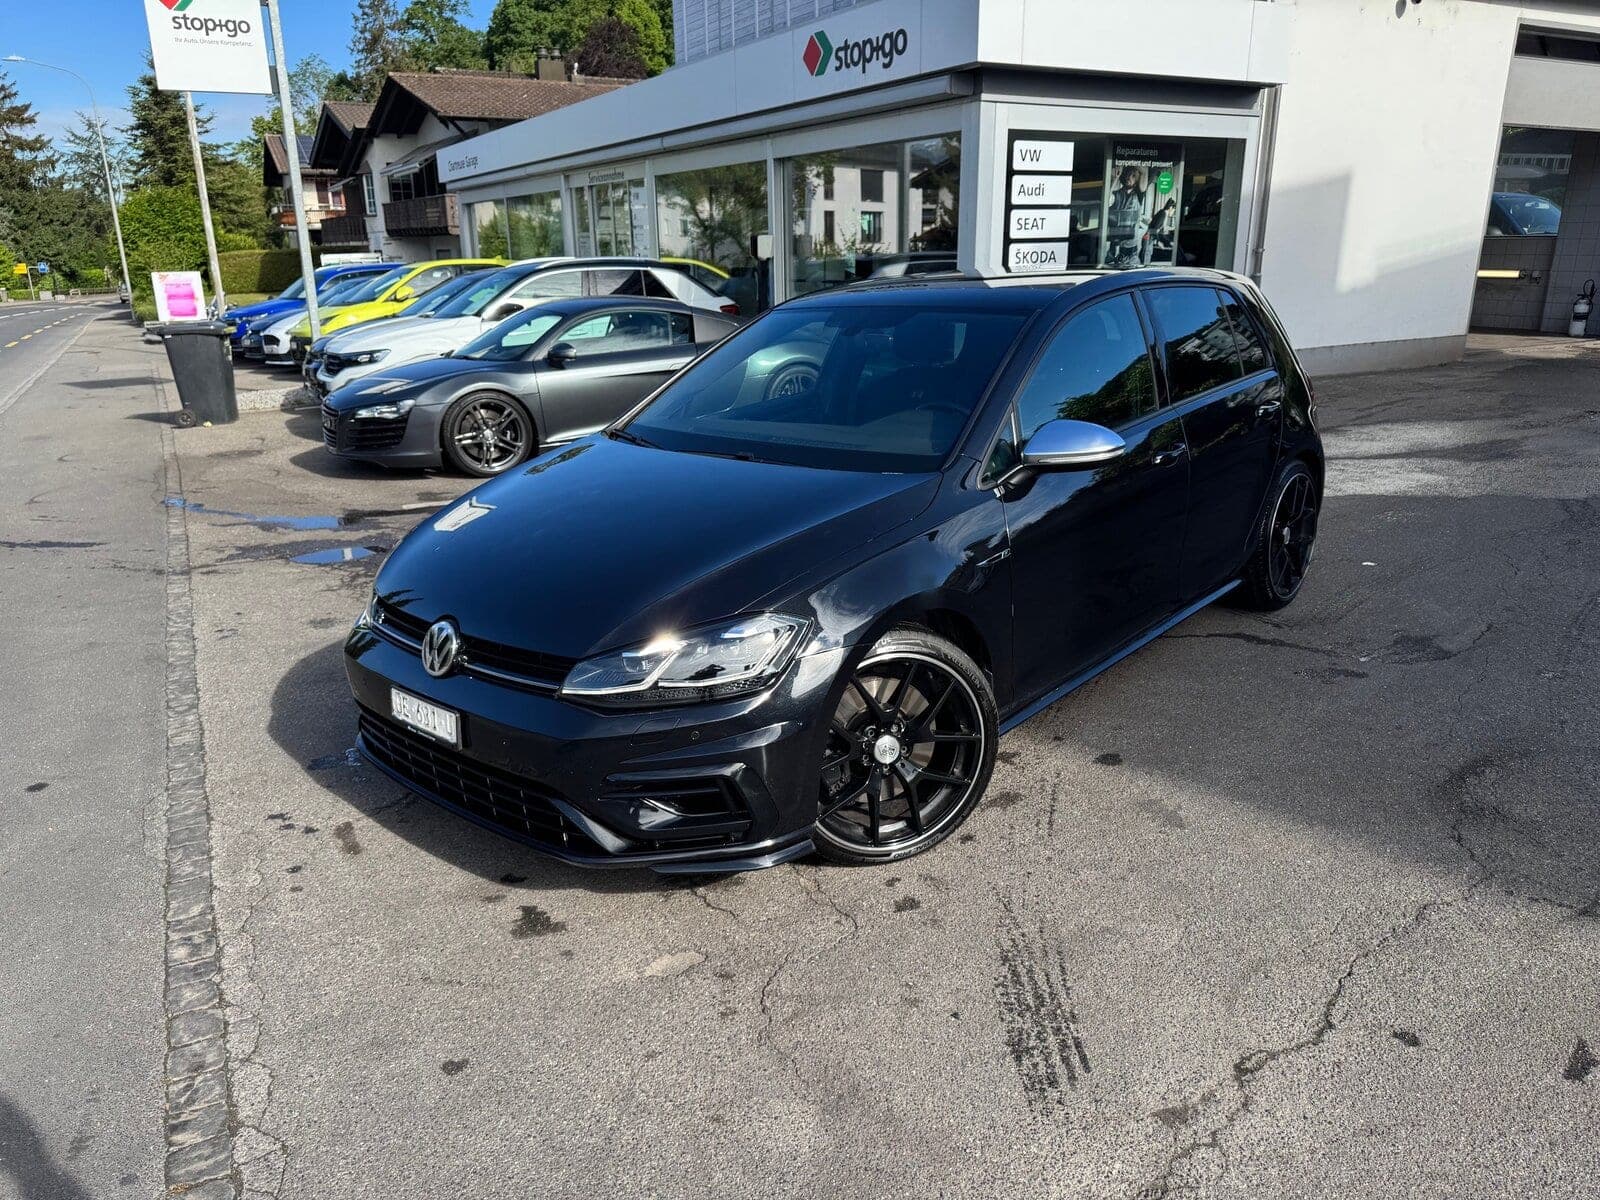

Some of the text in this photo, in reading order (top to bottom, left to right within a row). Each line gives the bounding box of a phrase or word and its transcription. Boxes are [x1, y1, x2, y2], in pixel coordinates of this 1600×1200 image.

[172, 14, 251, 37] stop+go
[834, 28, 908, 74] stop+go
[1020, 149, 1041, 162] VW
[1116, 145, 1159, 157] Reparaturen
[1018, 183, 1045, 197] Audi
[1016, 217, 1046, 231] SEAT
[1015, 249, 1057, 264] ŠKODA
